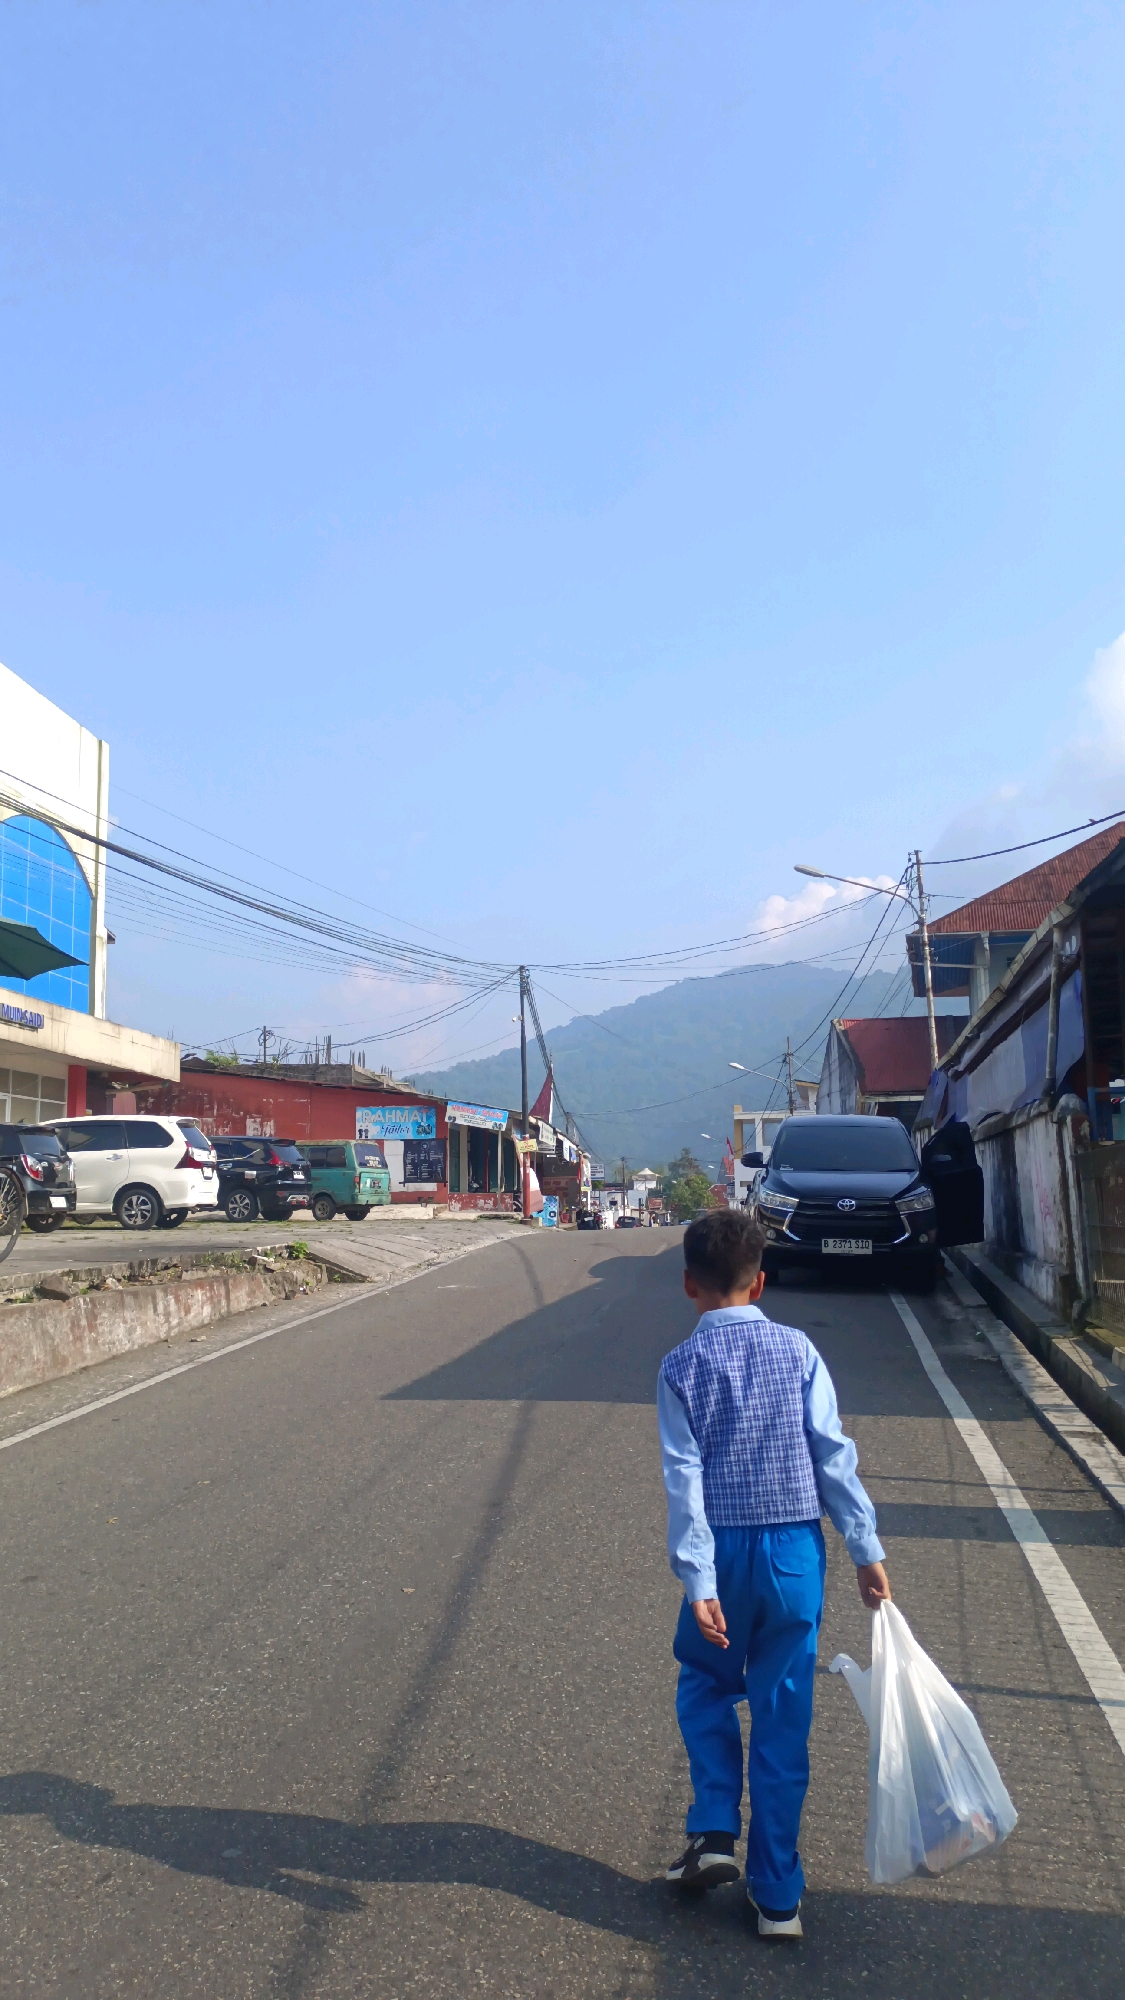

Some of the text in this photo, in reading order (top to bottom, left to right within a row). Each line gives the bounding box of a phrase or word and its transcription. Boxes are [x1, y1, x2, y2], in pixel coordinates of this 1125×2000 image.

[362, 1109, 428, 1123] RAHMAT
[823, 1239, 829, 1248] B
[832, 1239, 853, 1249] 2371
